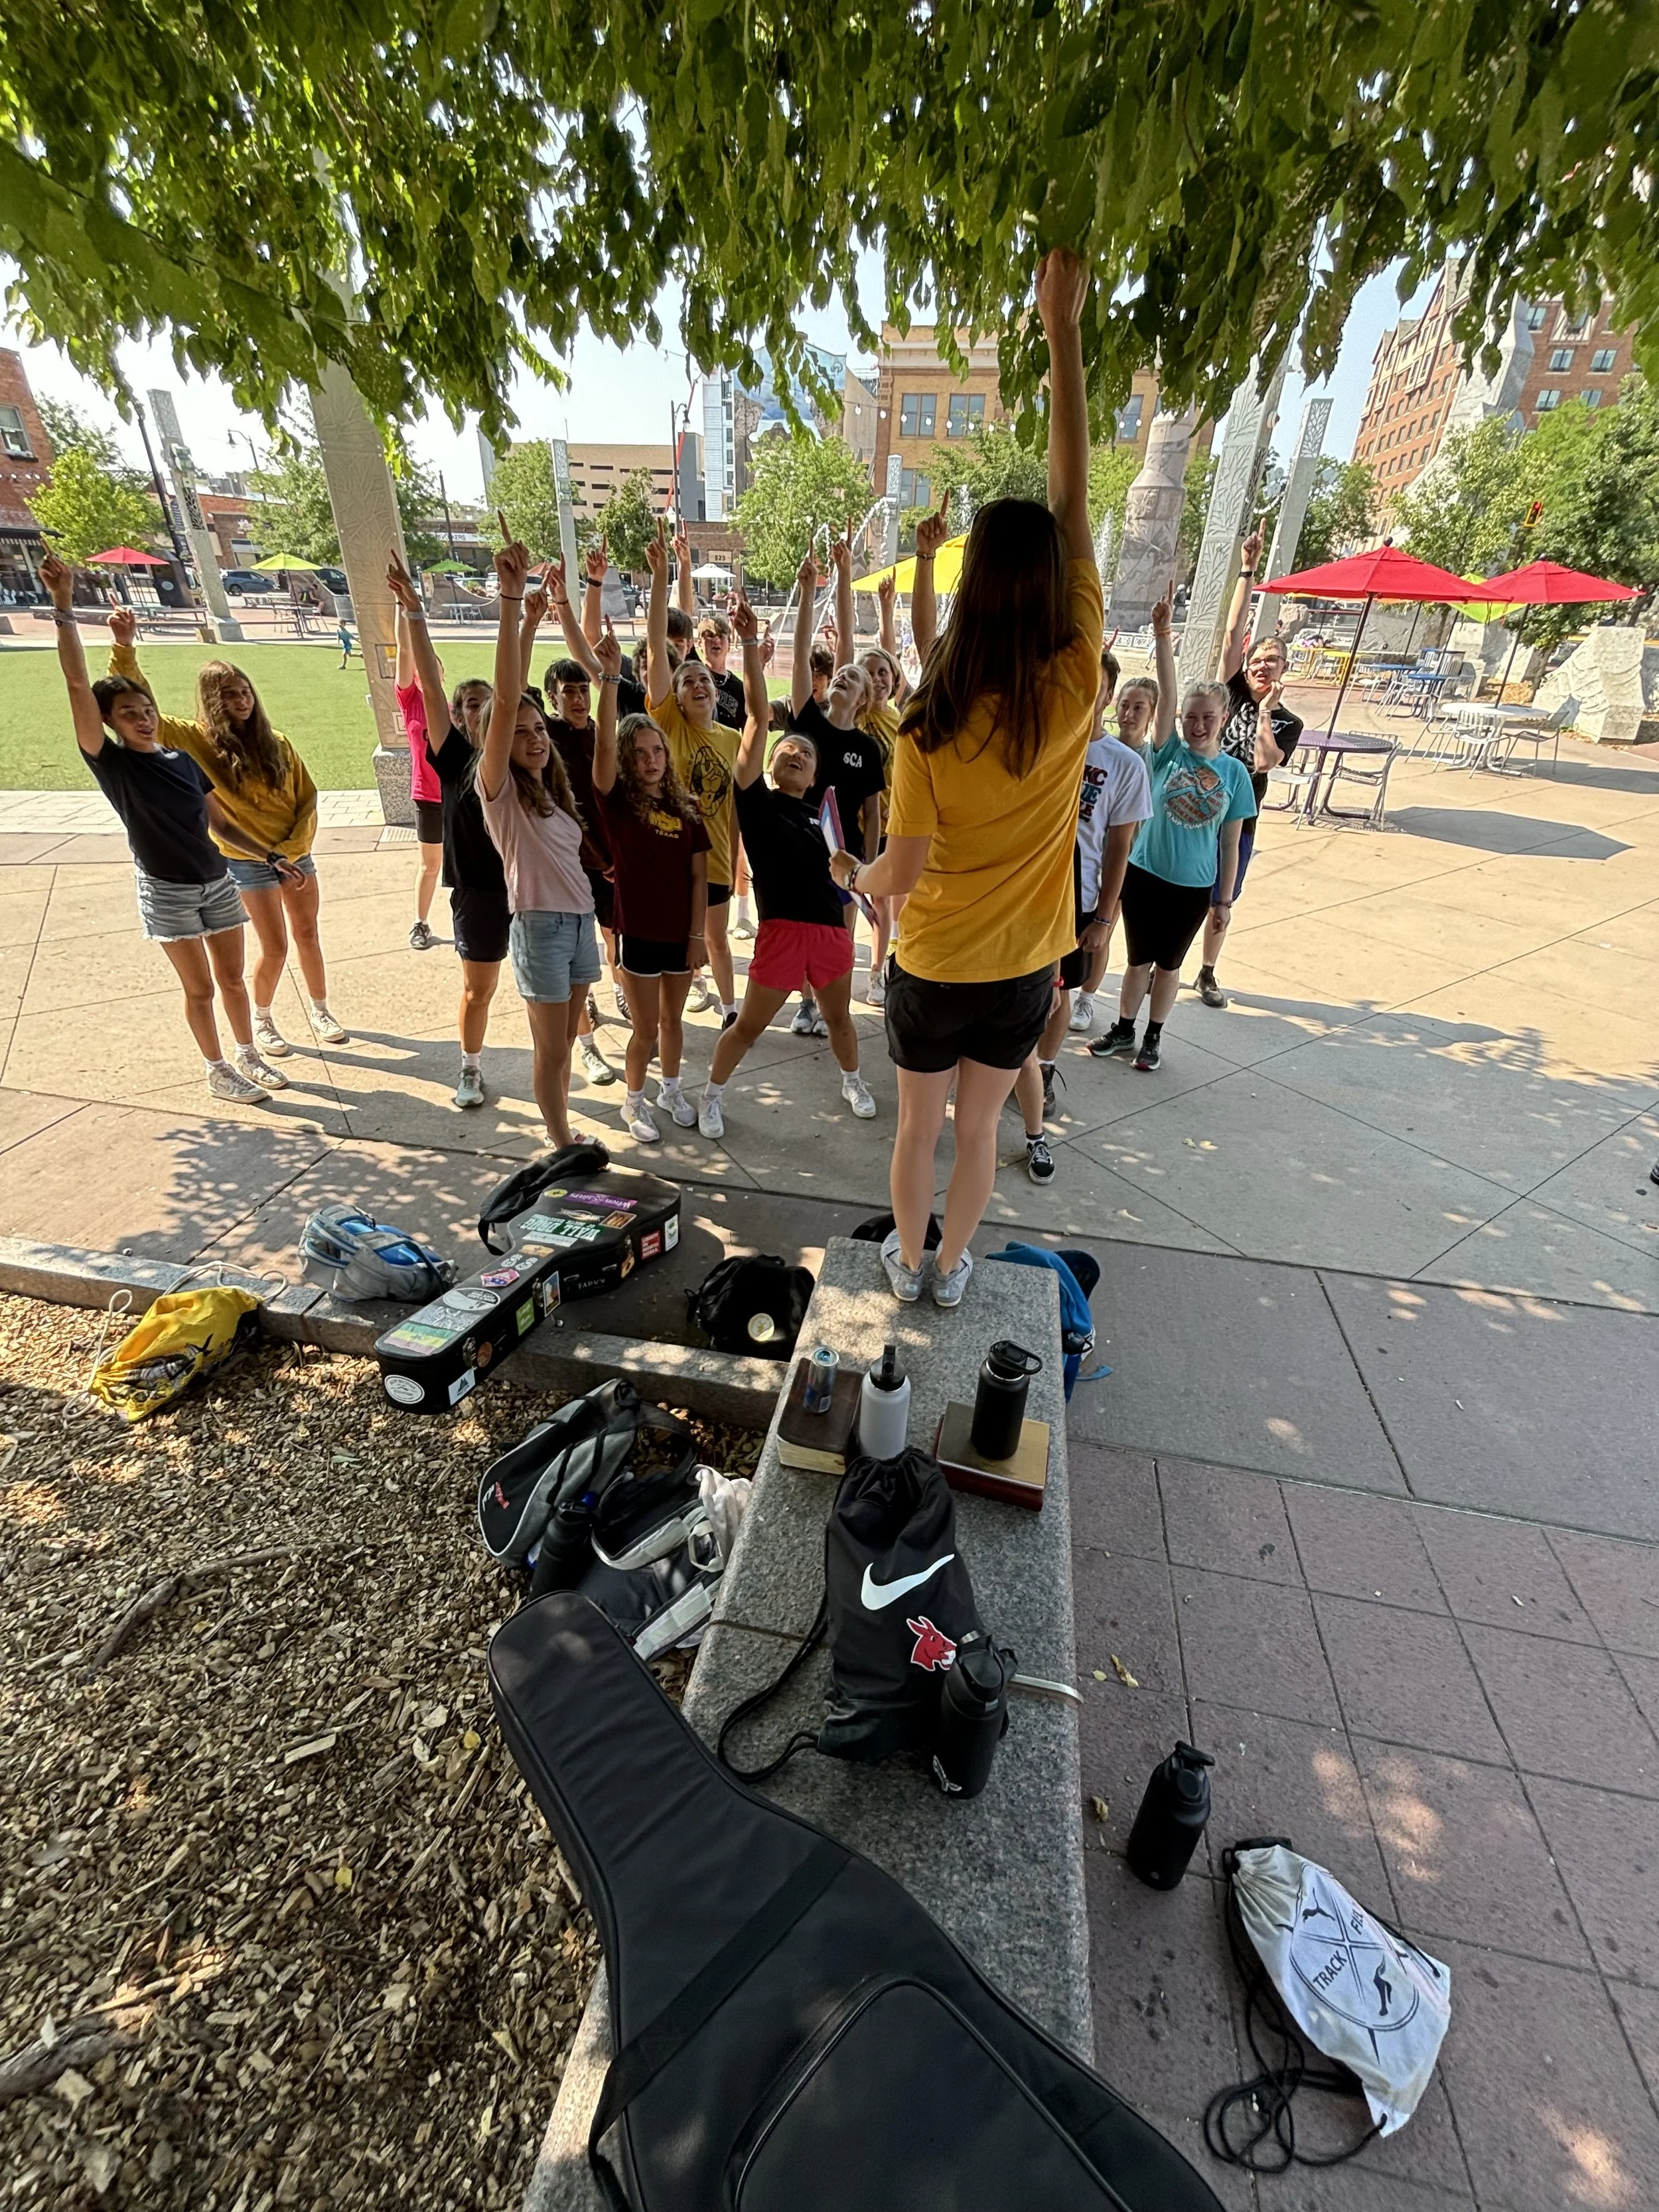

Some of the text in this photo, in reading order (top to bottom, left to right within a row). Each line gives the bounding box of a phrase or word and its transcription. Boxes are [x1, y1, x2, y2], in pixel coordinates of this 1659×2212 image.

[843, 752, 863, 768] SCA
[655, 829, 679, 839] TEXAS
[560, 1224, 601, 1242] WALL
[1313, 1950, 1348, 1991] TRACK
